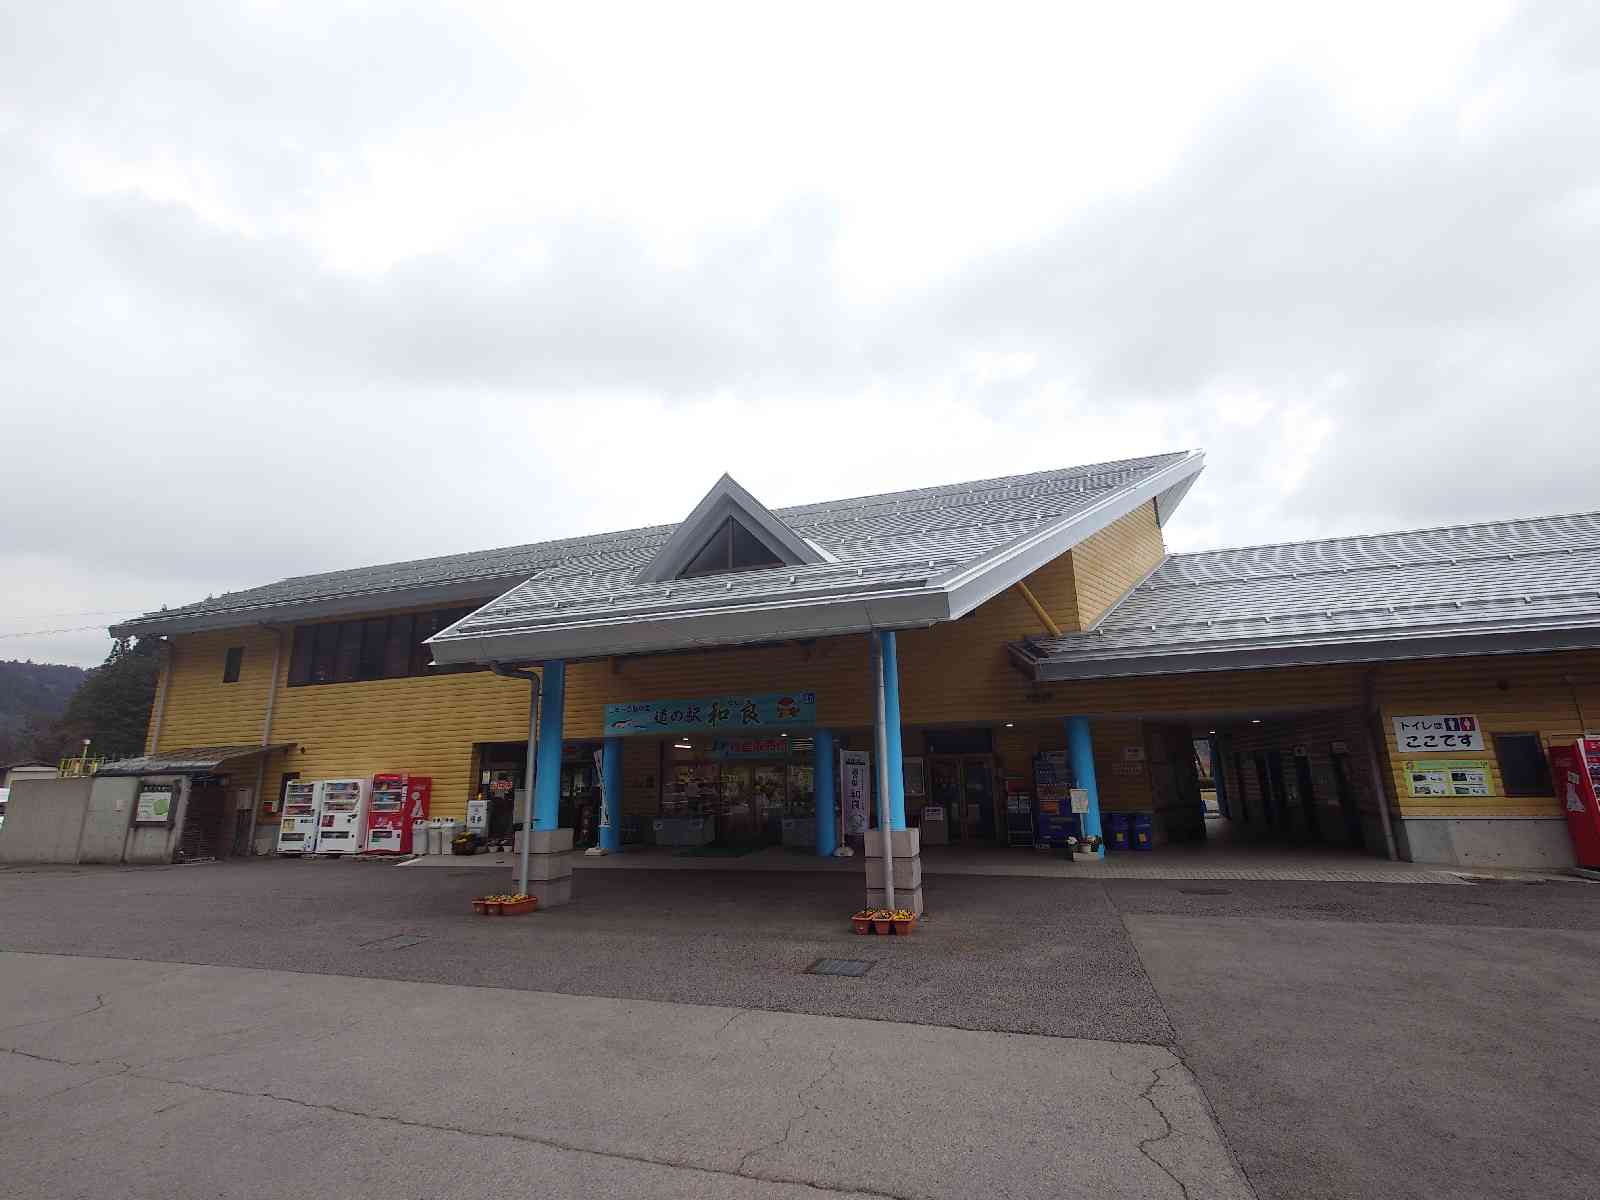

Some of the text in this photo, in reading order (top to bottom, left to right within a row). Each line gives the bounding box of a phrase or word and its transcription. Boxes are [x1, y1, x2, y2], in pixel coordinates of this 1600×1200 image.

[1401, 720, 1444, 731] トイレは
[1405, 734, 1473, 748] ここです
